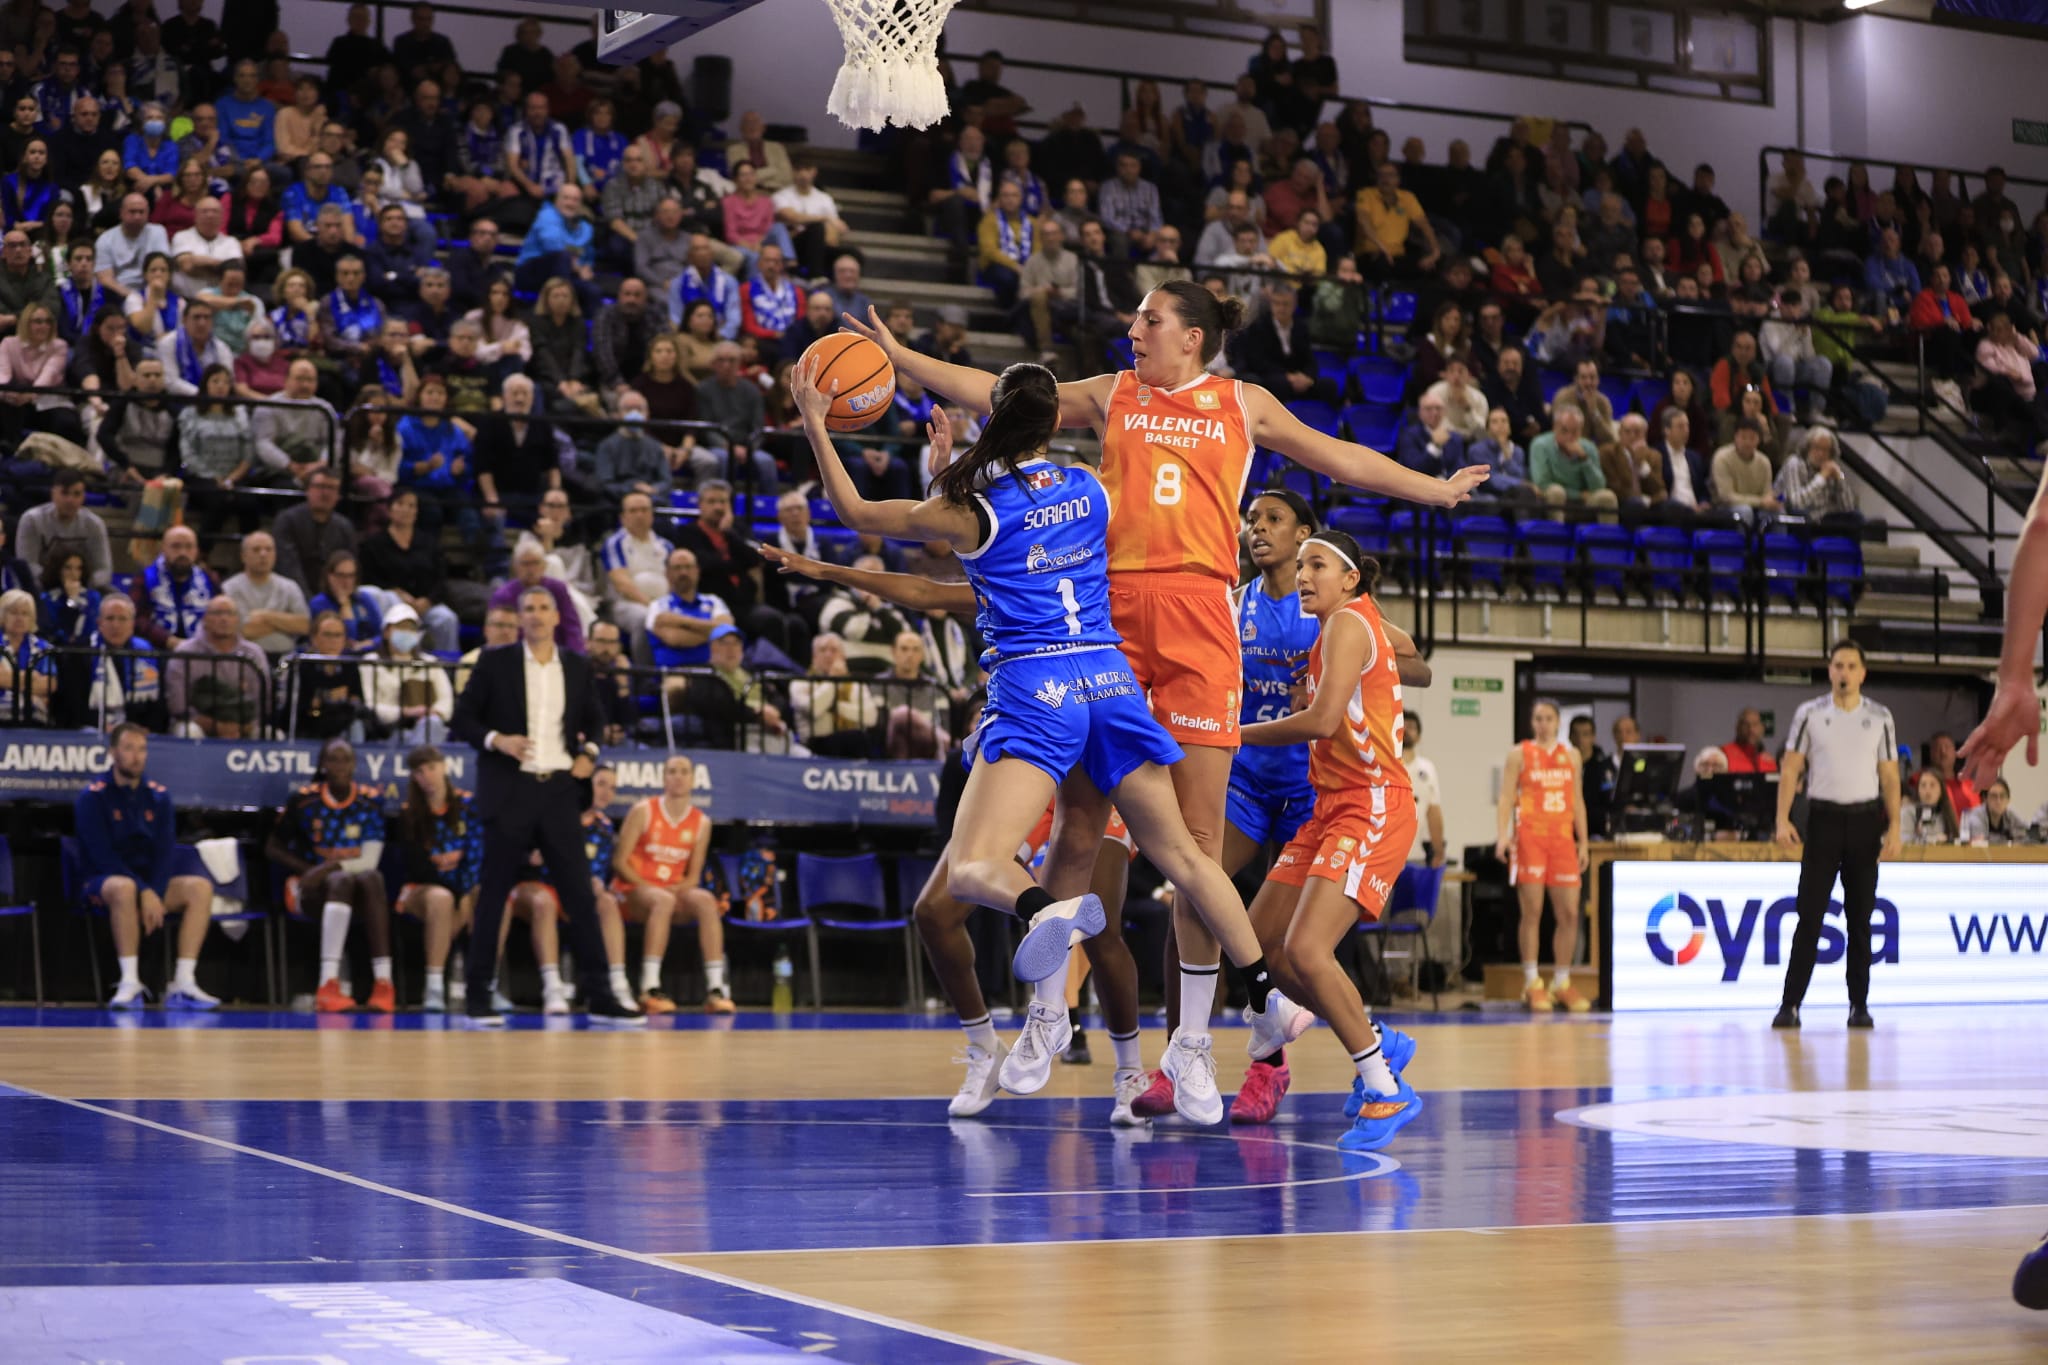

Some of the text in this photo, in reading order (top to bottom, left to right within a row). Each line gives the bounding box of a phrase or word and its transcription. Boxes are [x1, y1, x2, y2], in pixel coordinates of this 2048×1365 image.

[1123, 413, 1226, 445] VALENCIA
[1144, 432, 1200, 449] BASKET
[1153, 463, 1182, 505] 8
[1023, 495, 1091, 531] SORIANO
[1055, 577, 1082, 636] 1
[1095, 671, 1132, 687] RURAL
[365, 753, 387, 781] Y
[803, 767, 919, 795] CASTILLA
